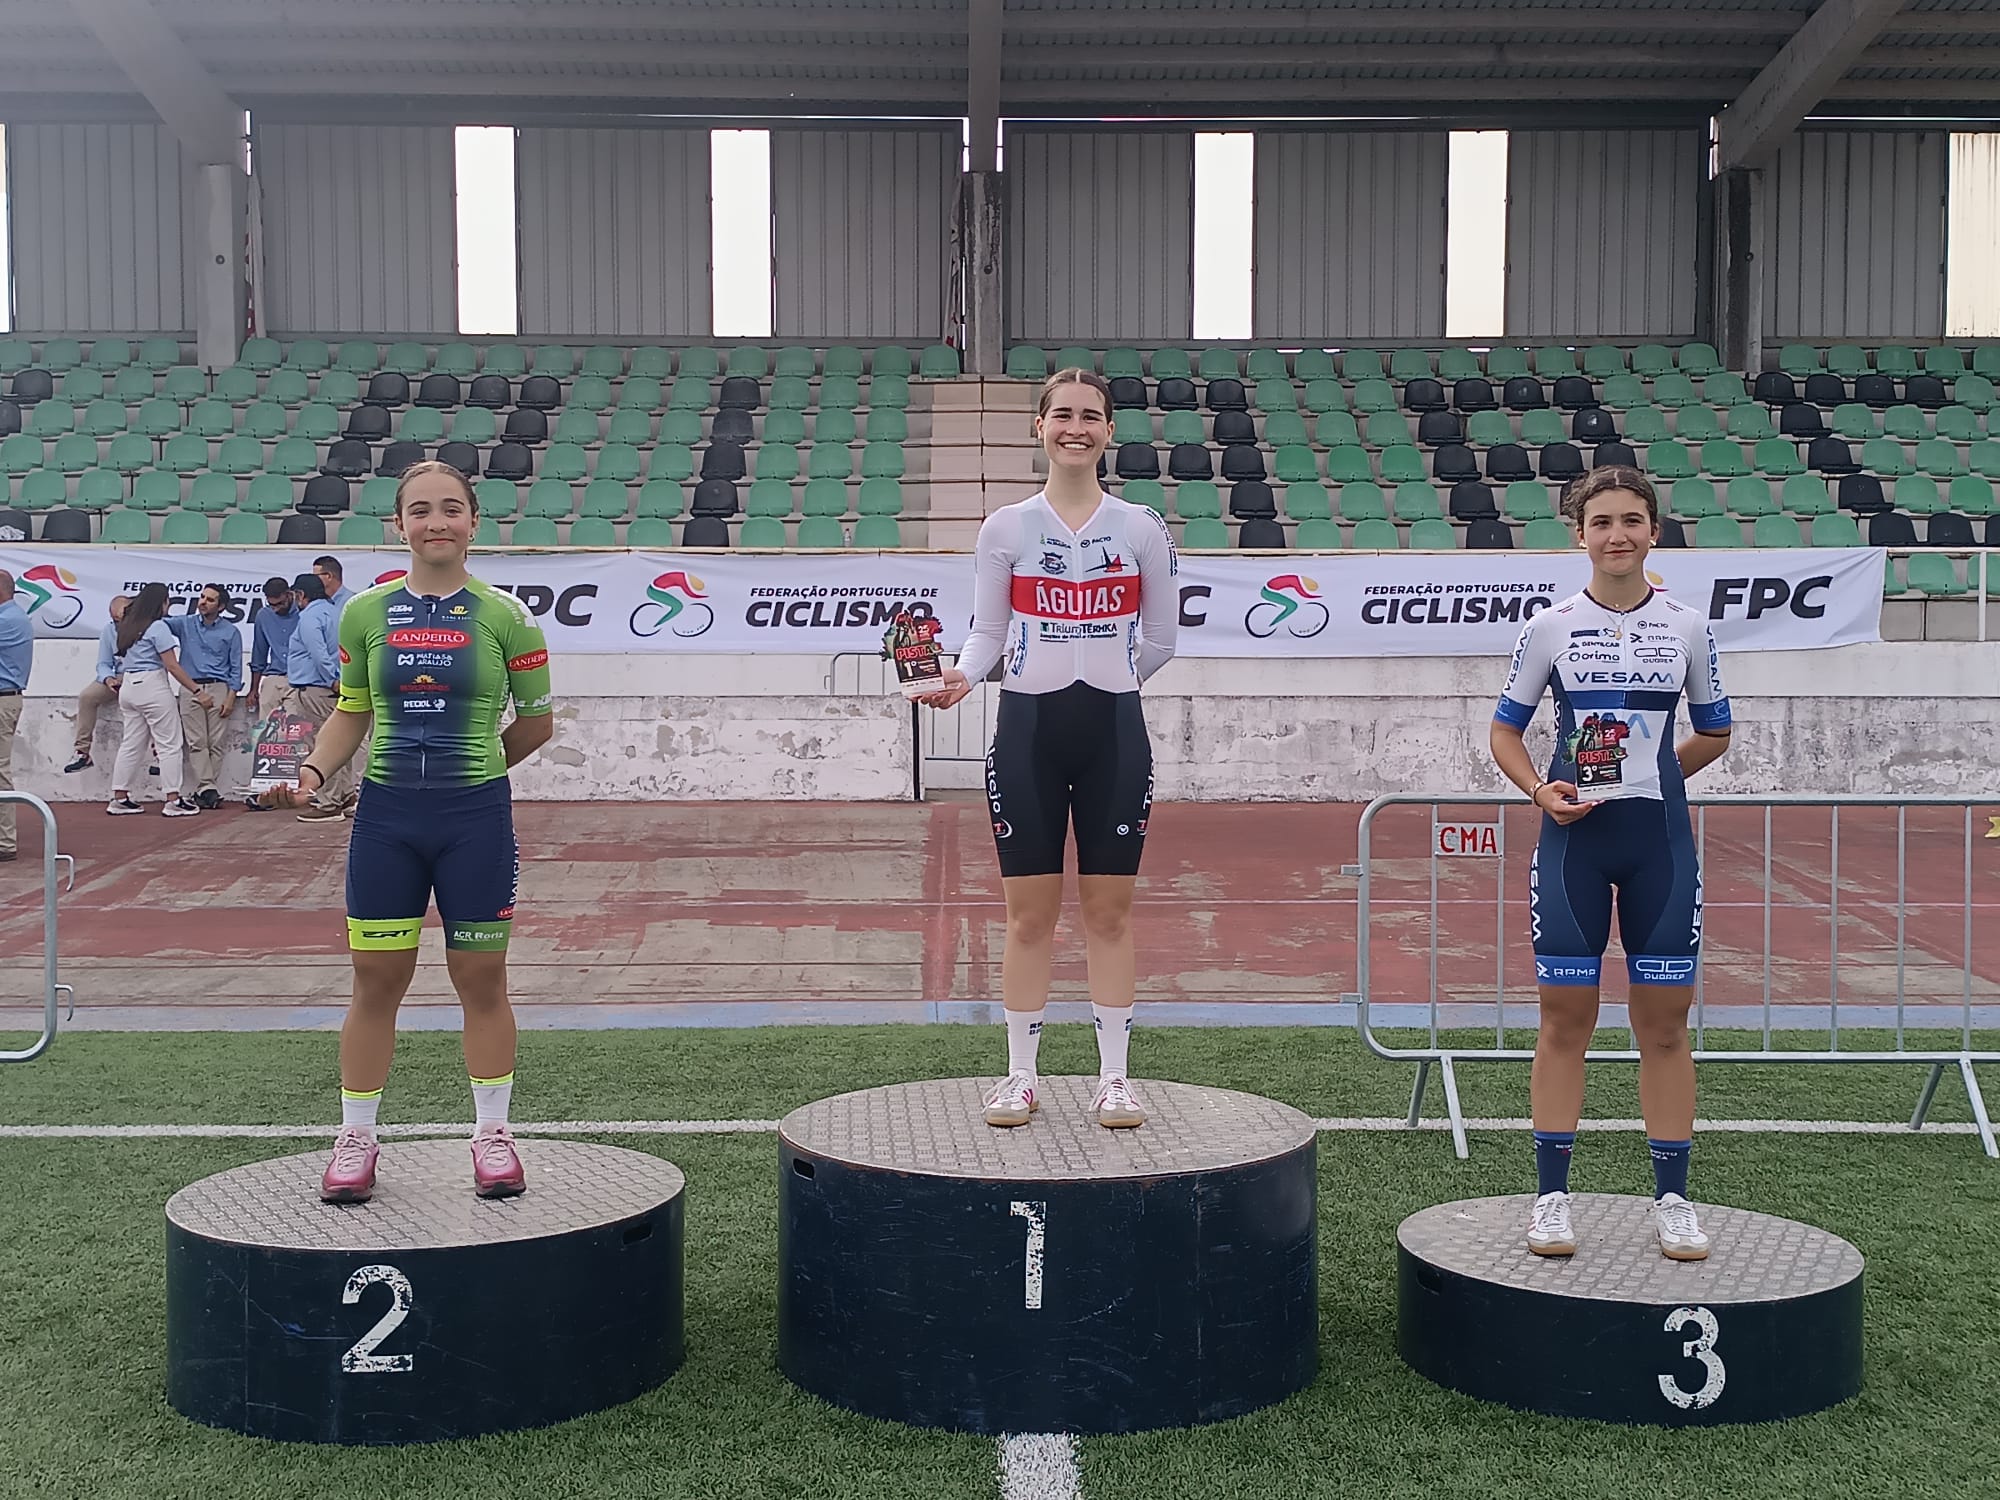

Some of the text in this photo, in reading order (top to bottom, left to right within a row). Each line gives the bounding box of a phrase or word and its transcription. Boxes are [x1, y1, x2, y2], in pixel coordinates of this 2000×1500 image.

[123, 581, 202, 595] FEDAÇÃO
[750, 586, 939, 599] FEDERAÇÃO PORTUGUESA DE
[1364, 583, 1556, 597] FEDERAÇÃO PORTUGUESA DE
[493, 584, 598, 626] PC
[1035, 581, 1126, 616] ÁGUIAS
[1708, 576, 1834, 620] FPC
[896, 644, 933, 660] PISTA
[1573, 671, 1674, 684] VESAM
[257, 743, 298, 756] PISTA
[1577, 750, 1617, 764] PISTA
[1440, 826, 1497, 854] CMA
[453, 930, 472, 939] ACR
[1010, 1201, 1046, 1309] 1
[342, 1264, 413, 1373] 2
[1658, 1306, 1726, 1409] 3
